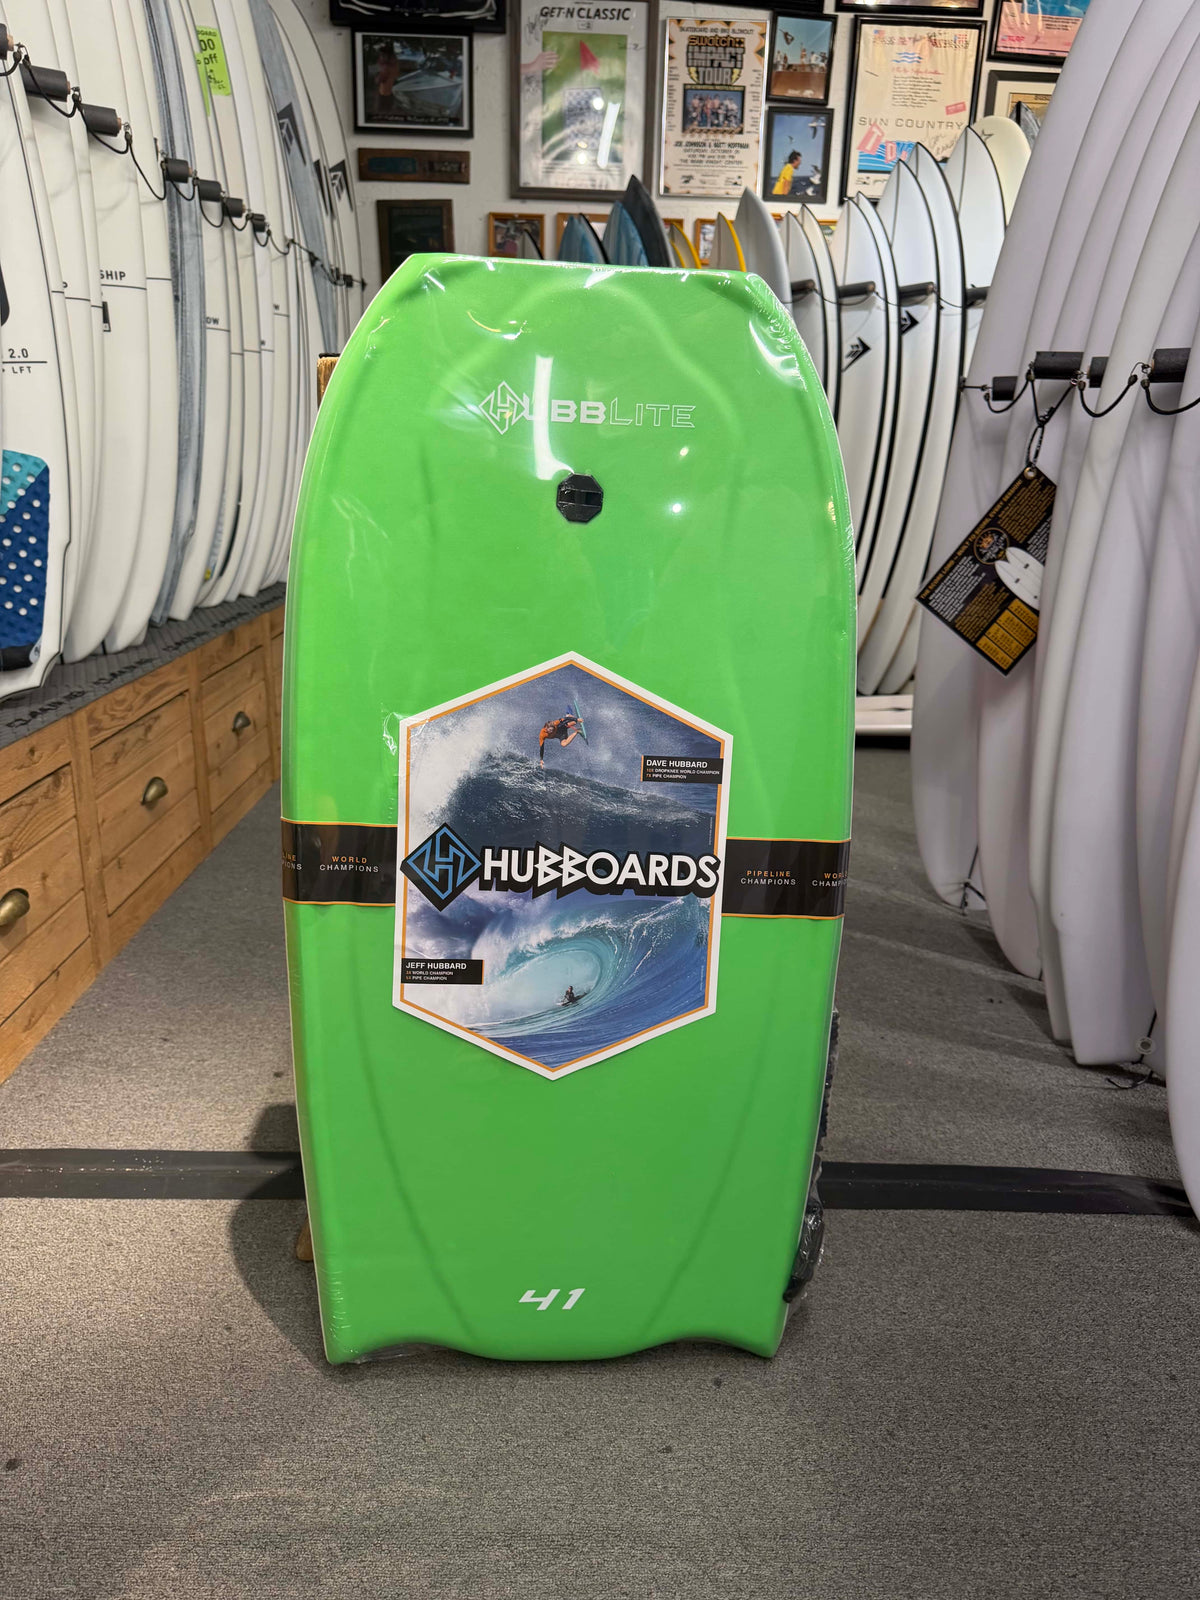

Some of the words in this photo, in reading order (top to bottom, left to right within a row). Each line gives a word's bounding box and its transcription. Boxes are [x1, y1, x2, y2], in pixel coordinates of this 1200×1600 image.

[577, 8, 631, 20] CLASSIC
[688, 35, 735, 47] swatch
[204, 53, 218, 65] off
[696, 68, 732, 84] TOUR
[858, 116, 888, 126] SUN
[895, 118, 964, 130] COUNTRY
[8, 348, 28, 358] 2.0
[12, 366, 31, 374] LFT
[646, 759, 667, 767] DAVE
[669, 760, 708, 768] HUBBARD
[331, 856, 367, 864] WORLD
[483, 842, 718, 889] HUBBOARDS
[319, 864, 379, 873] CHAMPIONS
[740, 877, 796, 885] CHAMPIONS
[518, 1288, 586, 1311] 41
